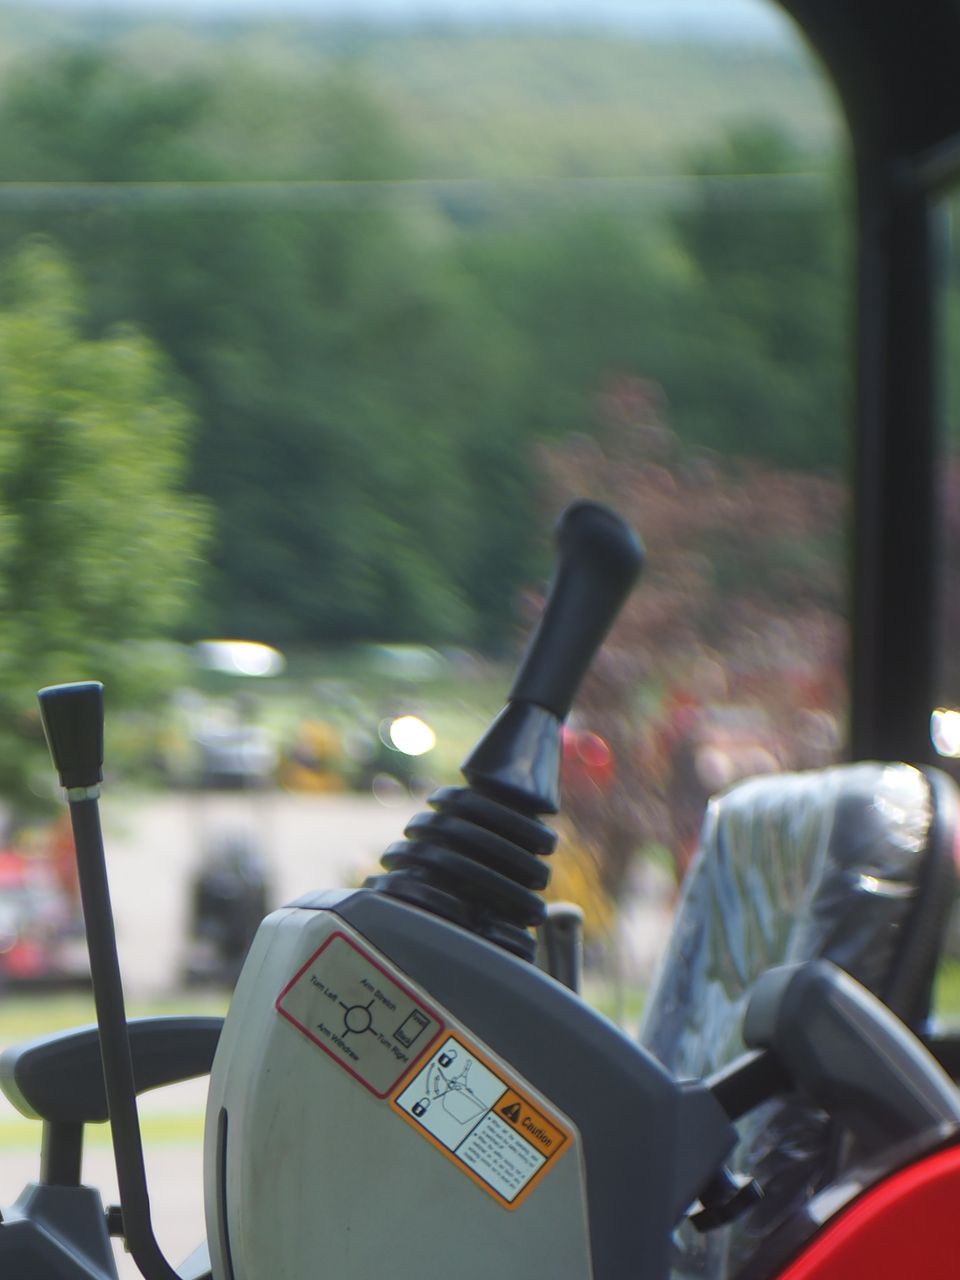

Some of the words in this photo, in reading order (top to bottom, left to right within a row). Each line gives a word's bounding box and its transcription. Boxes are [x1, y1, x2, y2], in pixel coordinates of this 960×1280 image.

[309, 975, 325, 991] Turn
[324, 988, 339, 1002] Left
[360, 978, 375, 993] Arm
[317, 1022, 332, 1036] Arm
[377, 1033, 392, 1049] Turn
[391, 1045, 410, 1064] Right
[521, 1116, 553, 1148] Caution
